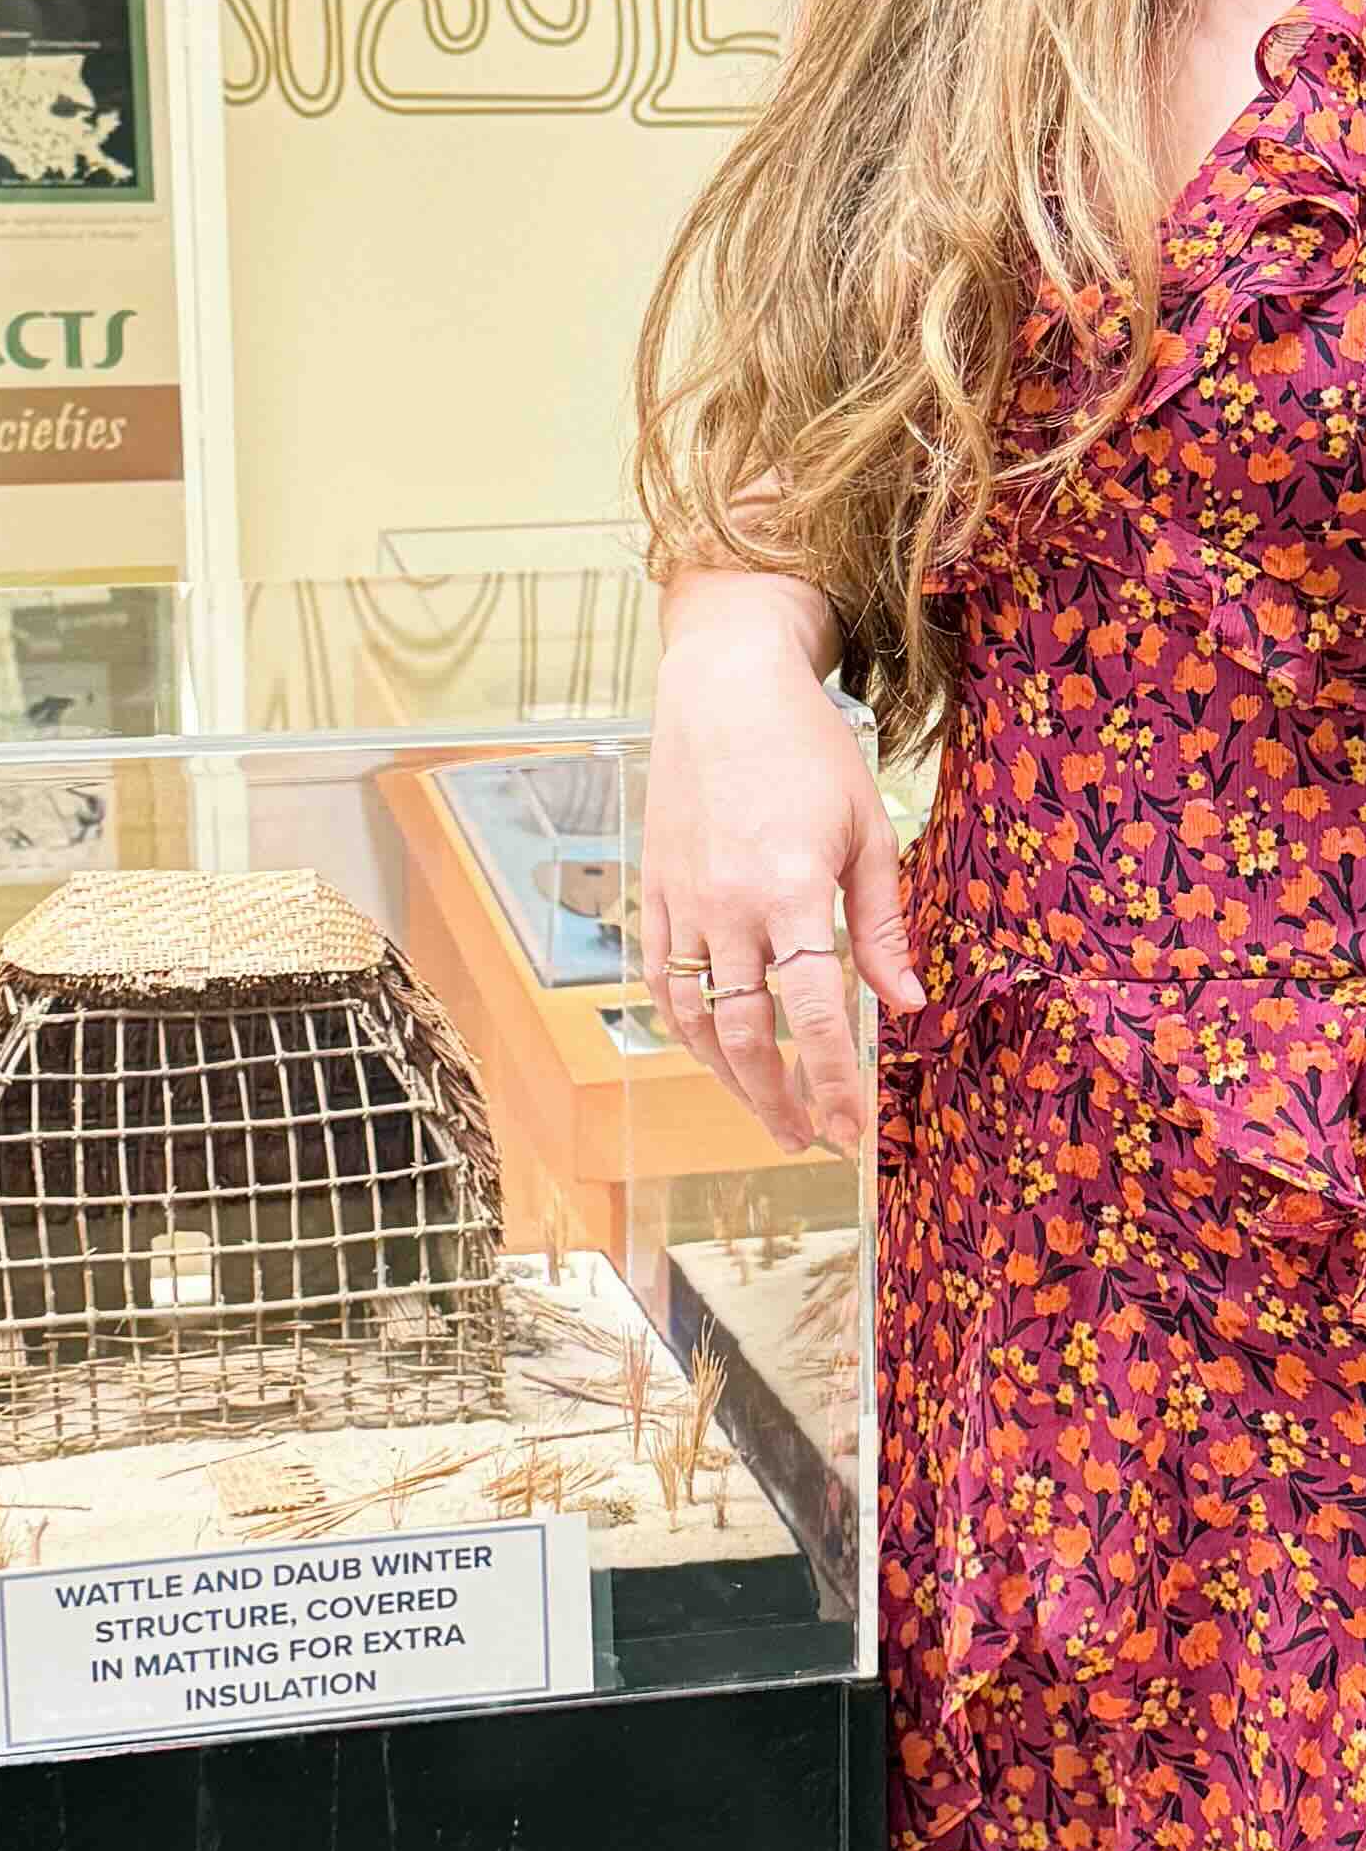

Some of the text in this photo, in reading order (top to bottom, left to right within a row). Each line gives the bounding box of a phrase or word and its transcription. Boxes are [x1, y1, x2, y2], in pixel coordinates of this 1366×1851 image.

[55, 1546, 493, 1610] WATTLE AND DAUB WINTER
[95, 1586, 459, 1644] STRUCTURE, COVERED
[91, 1623, 465, 1683] IN MATTING FOR EXTRA
[186, 1670, 377, 1712] INSULATION
